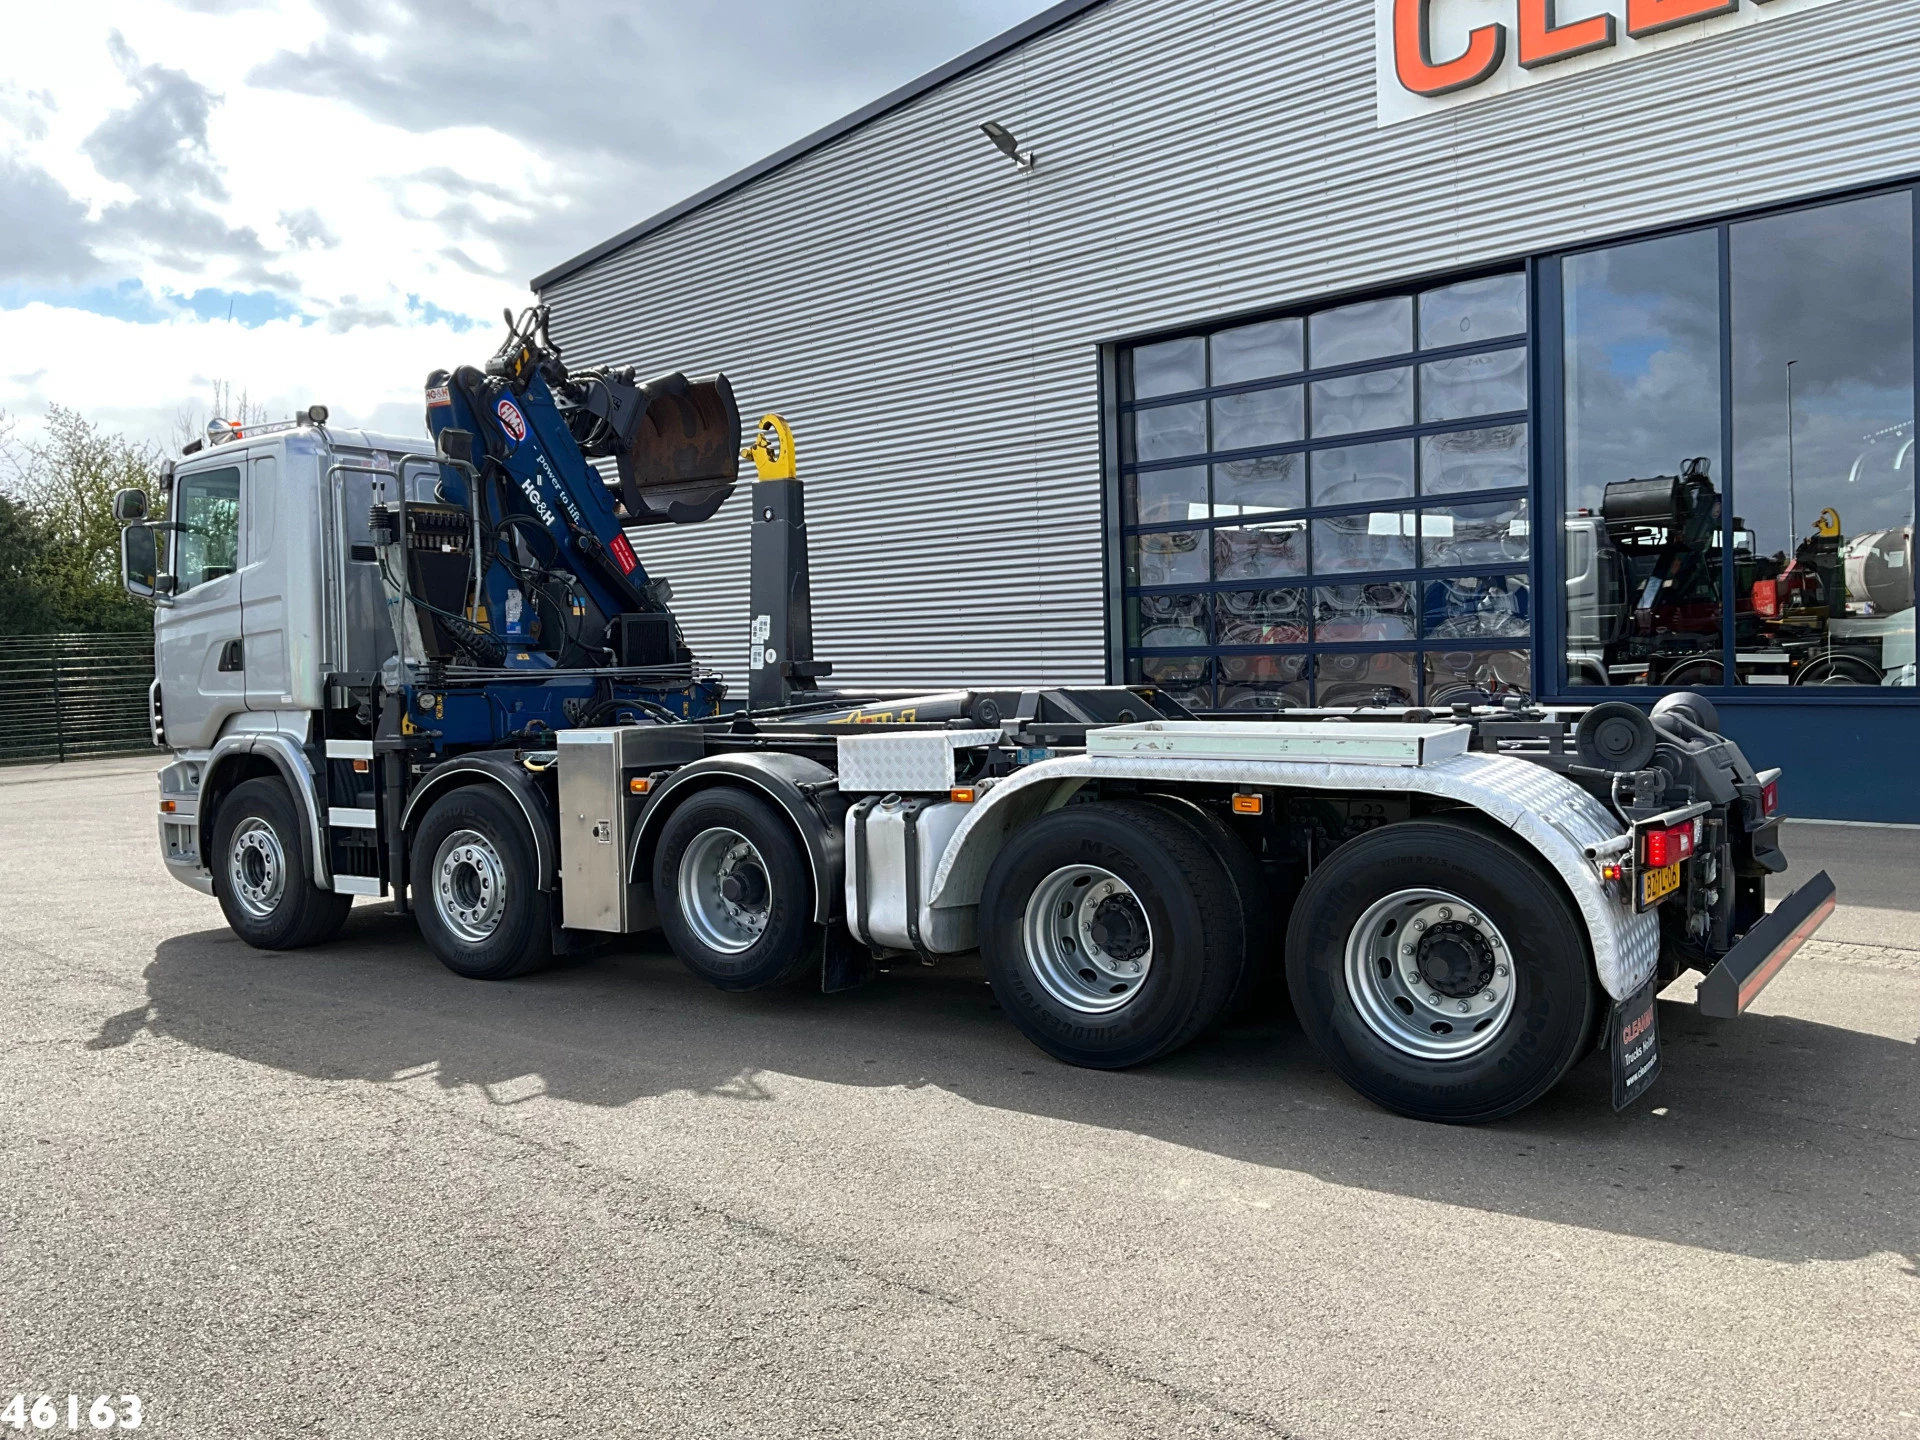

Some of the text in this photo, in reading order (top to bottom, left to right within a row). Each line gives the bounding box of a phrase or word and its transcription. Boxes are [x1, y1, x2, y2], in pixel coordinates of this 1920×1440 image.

[536, 454, 562, 490] power
[560, 491, 569, 504] to
[567, 503, 580, 525] lift.
[1625, 1046, 1642, 1066] Trucks
